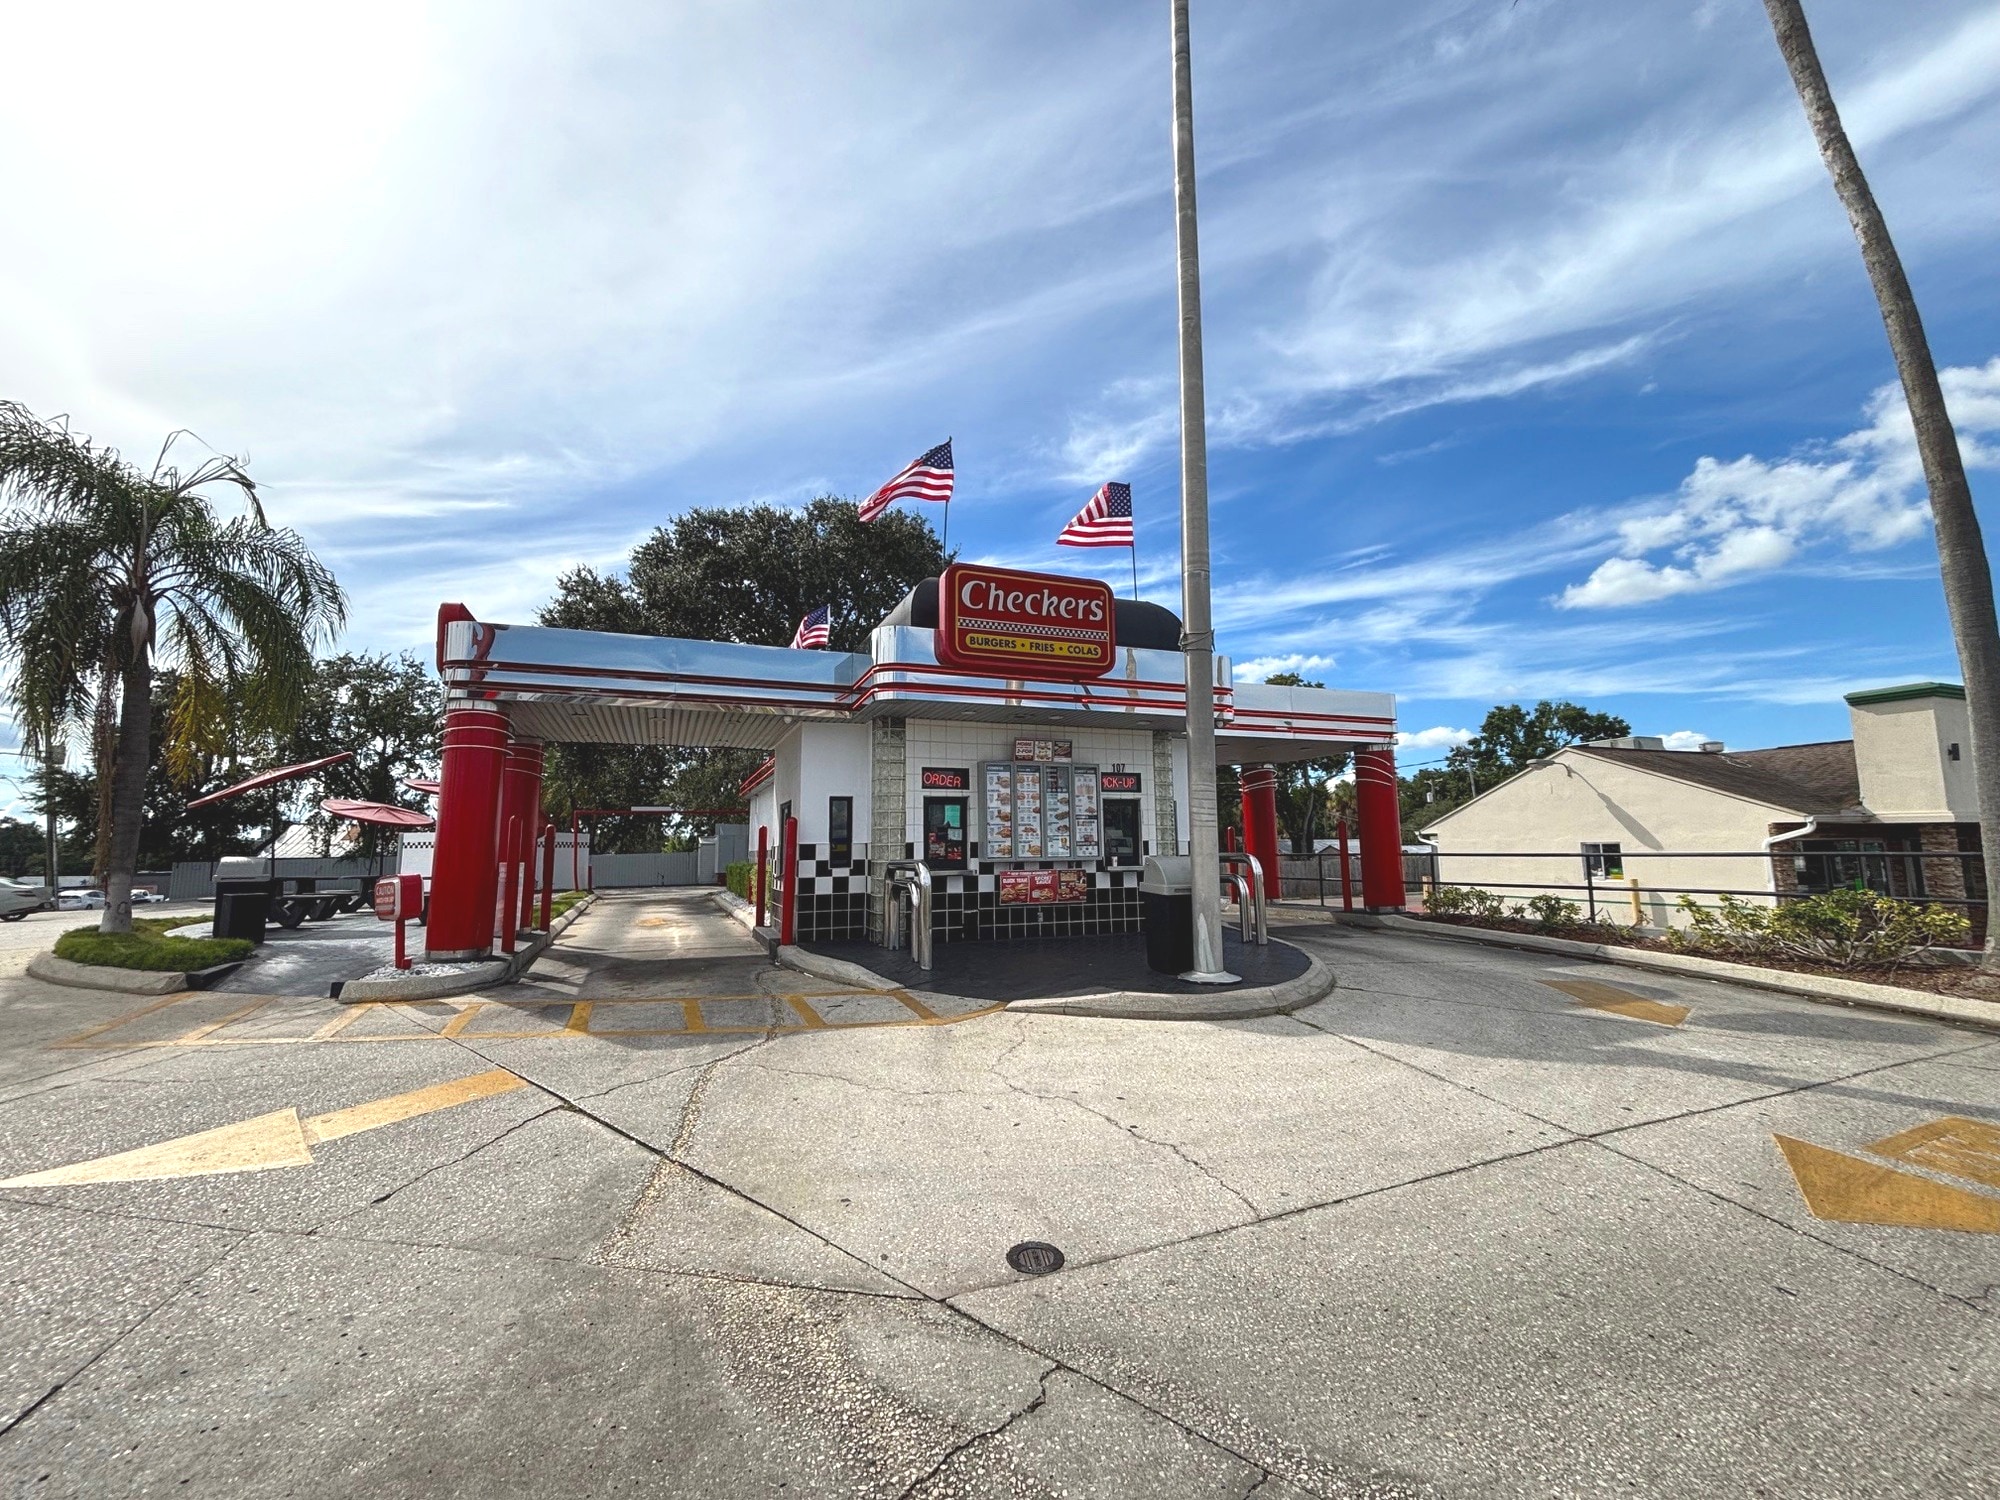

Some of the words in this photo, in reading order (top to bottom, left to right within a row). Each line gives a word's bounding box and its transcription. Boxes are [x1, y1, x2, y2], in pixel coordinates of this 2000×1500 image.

[961, 580, 1104, 621] Checkers
[969, 635, 1017, 649] BURGERS
[1029, 641, 1055, 652] FRIES
[1067, 645, 1099, 656] COLAS
[1112, 763, 1126, 773] 107
[923, 772, 962, 788] ORDER
